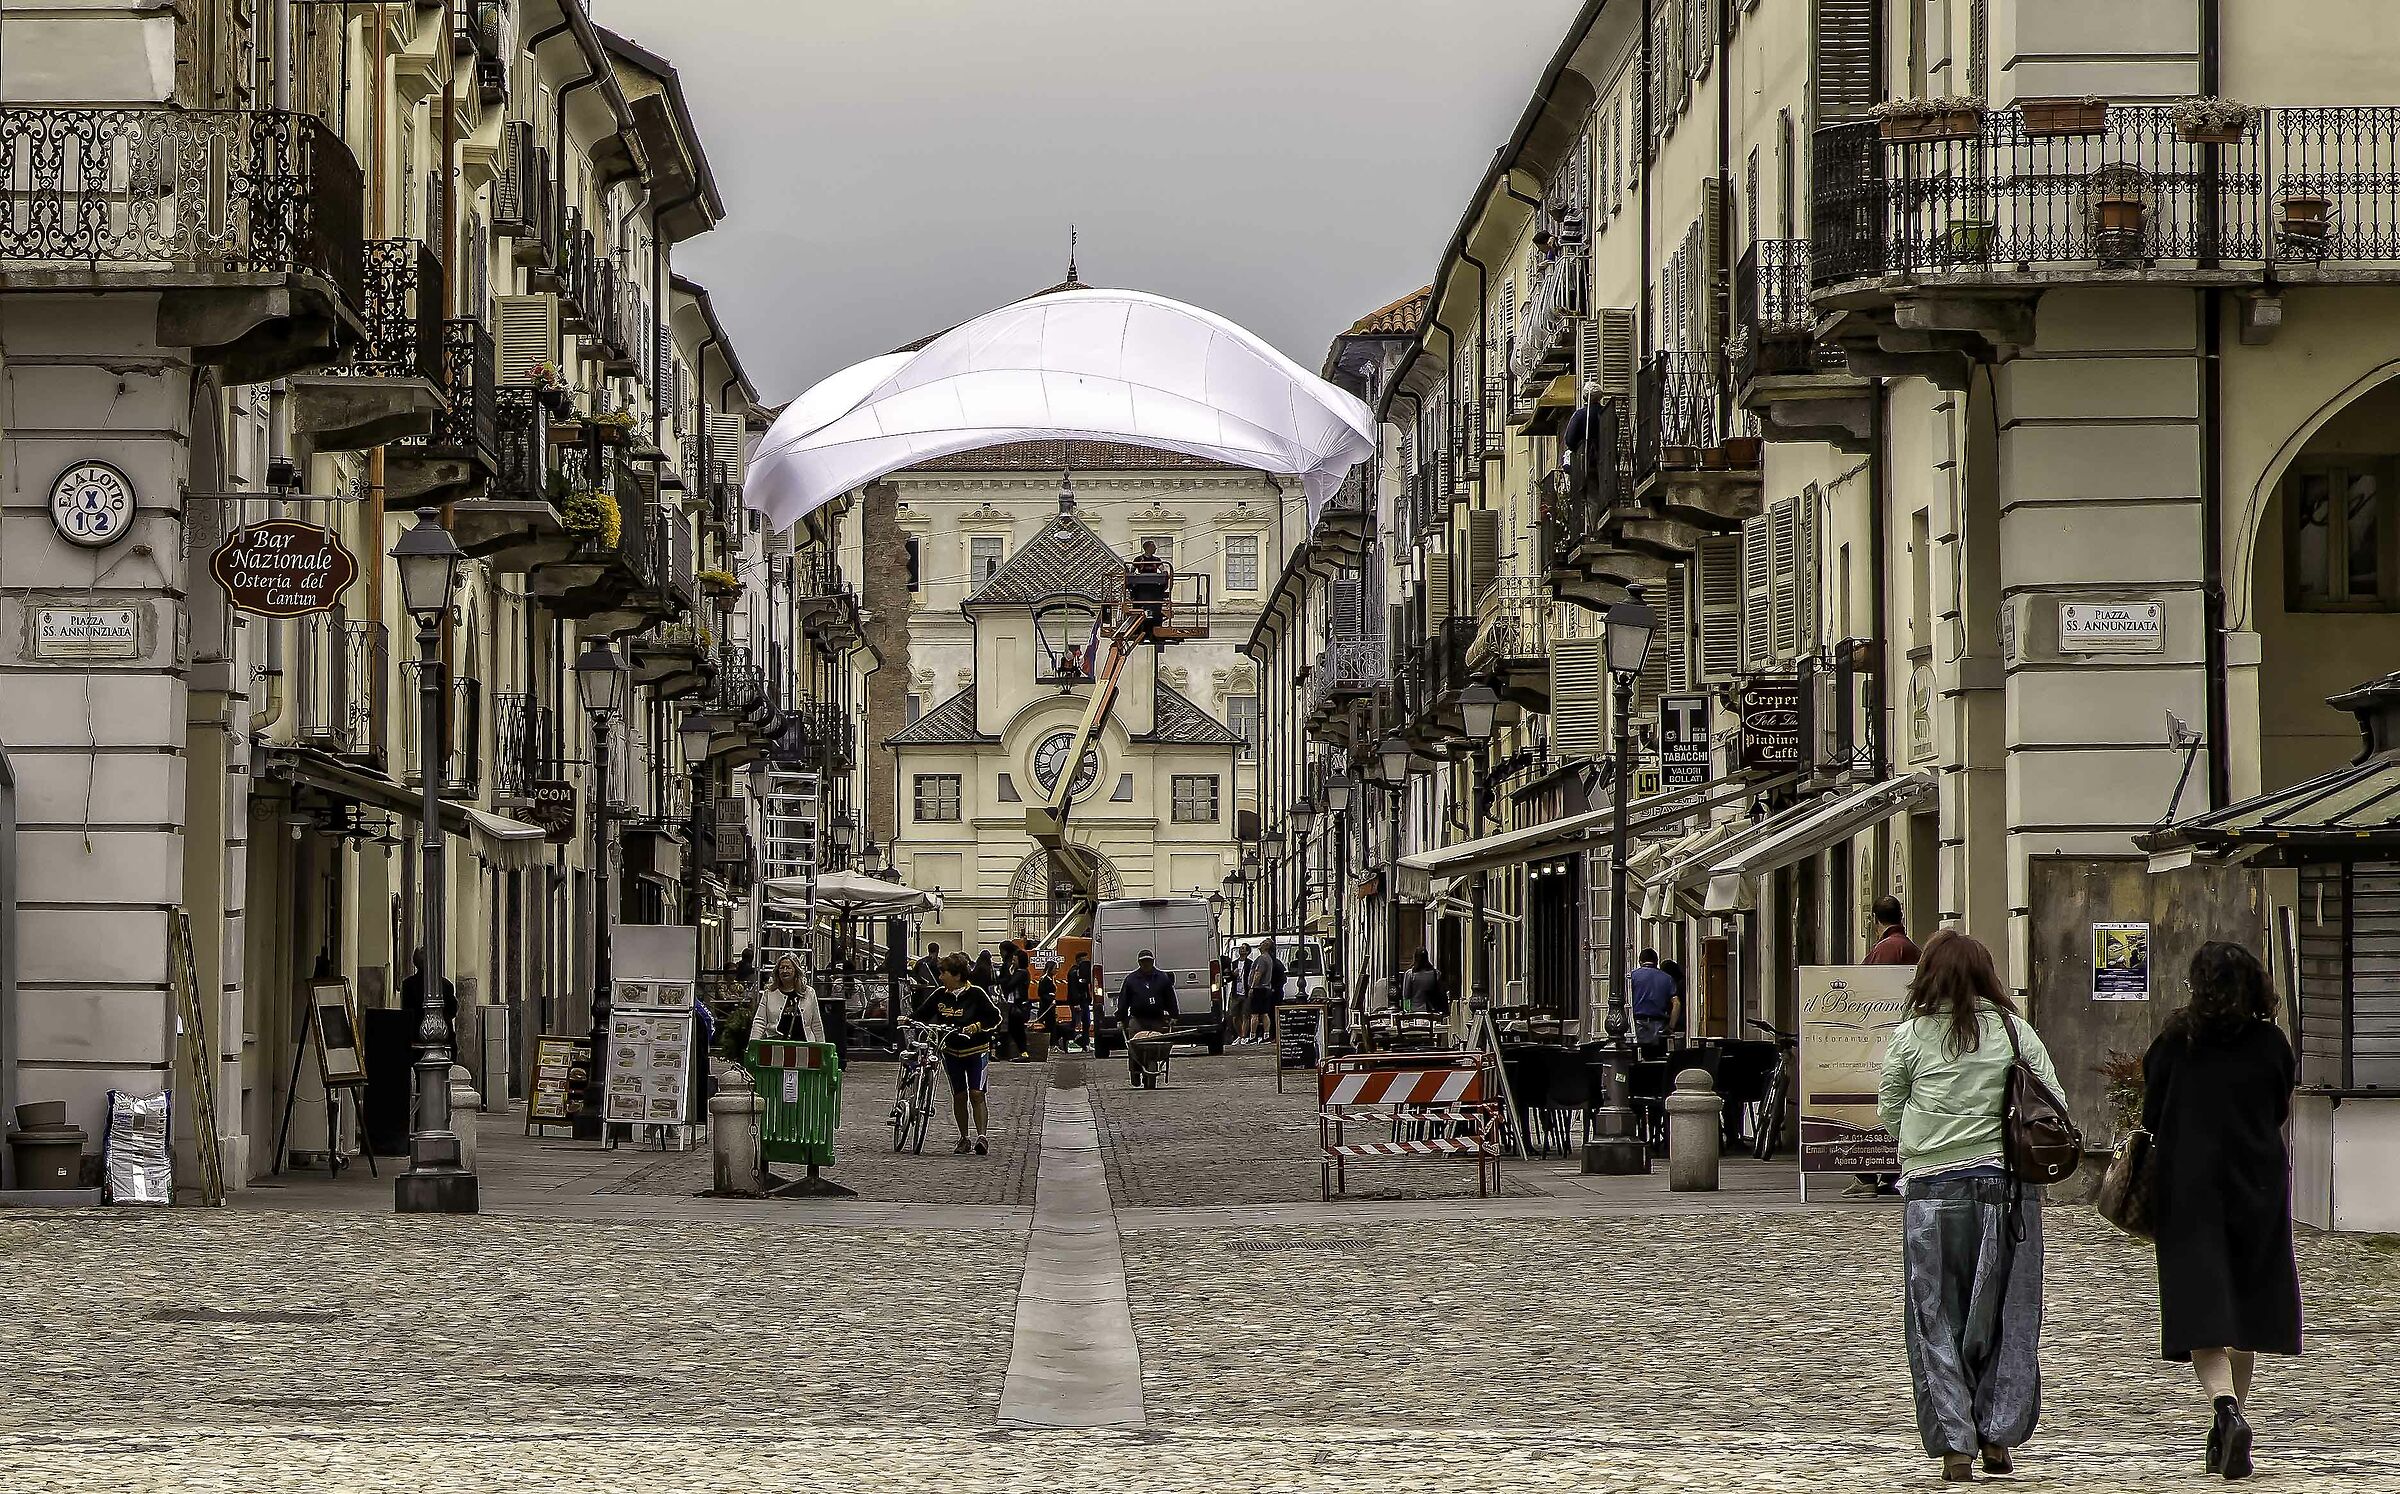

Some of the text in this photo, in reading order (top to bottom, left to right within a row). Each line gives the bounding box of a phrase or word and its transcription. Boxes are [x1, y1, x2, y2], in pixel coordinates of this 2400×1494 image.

[59, 469, 124, 510] ENALOTTO
[85, 491, 98, 509] X
[76, 512, 108, 530] 1 2
[253, 530, 295, 548] Bar
[229, 547, 332, 570] Nazionale
[233, 571, 328, 589] Osteria del
[267, 588, 317, 606] Cantun
[70, 615, 105, 625] PIAZZA
[2095, 610, 2130, 620] PIAZZA
[43, 626, 132, 637] SS. ANNUNZIATA
[2066, 620, 2159, 631] SS. ANNUNZIATA
[1745, 691, 1799, 709] Creper
[1667, 700, 1702, 743] T
[1779, 714, 1799, 726] Lu
[1663, 751, 1708, 762] TABACCHI
[1669, 775, 1703, 783] BOLLATI
[1671, 767, 1701, 775] VALORI
[1638, 773, 1660, 792] LOT
[1803, 995, 1819, 1012] il
[1859, 1156, 1864, 1165] 7
